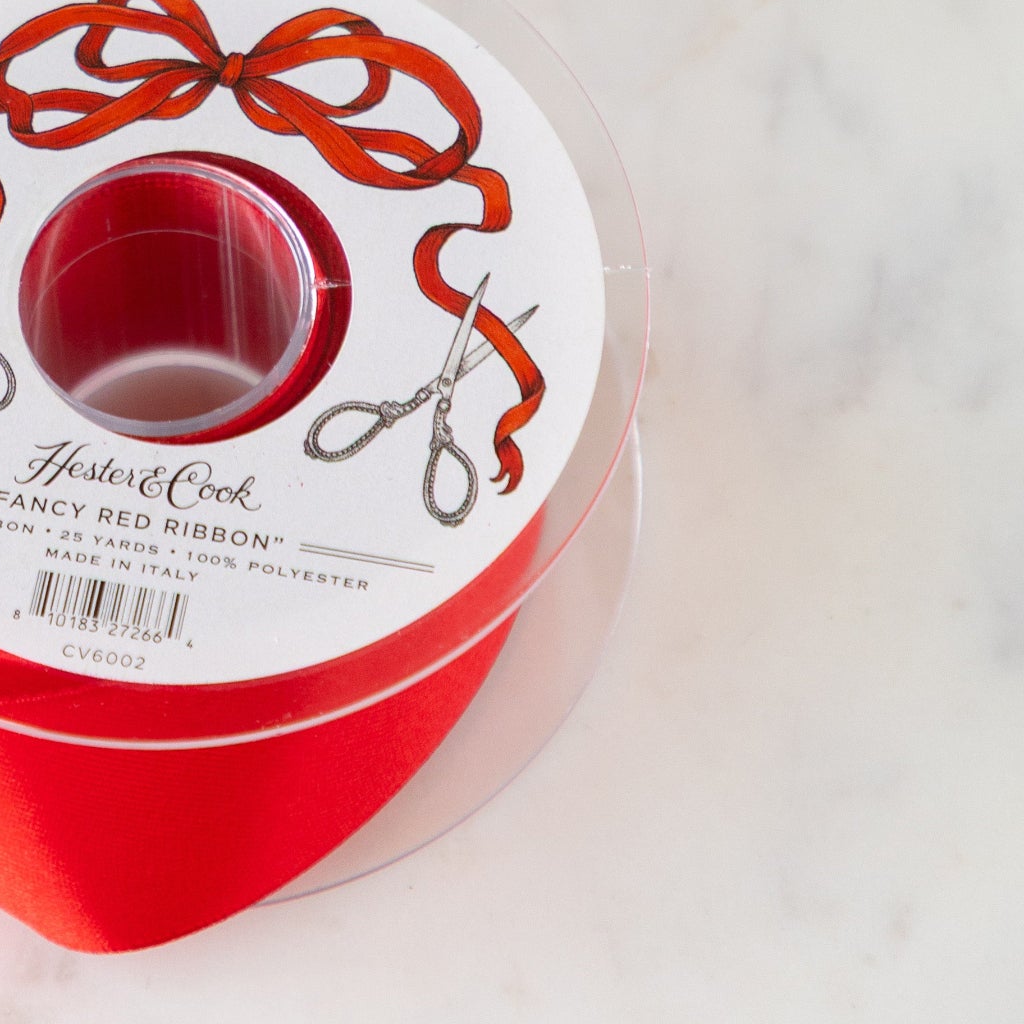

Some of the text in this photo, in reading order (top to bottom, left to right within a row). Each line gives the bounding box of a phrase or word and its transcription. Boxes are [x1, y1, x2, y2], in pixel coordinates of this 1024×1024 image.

[97, 506, 151, 530] RED
[45, 547, 199, 582] MADE IN ITALY
[59, 530, 83, 543] 25
[93, 535, 159, 556] YARDS
[187, 550, 237, 570] 100%
[248, 561, 369, 591] POLYESTER
[12, 609, 194, 649] 8 10183 27266 4
[62, 644, 146, 670] CV6002
